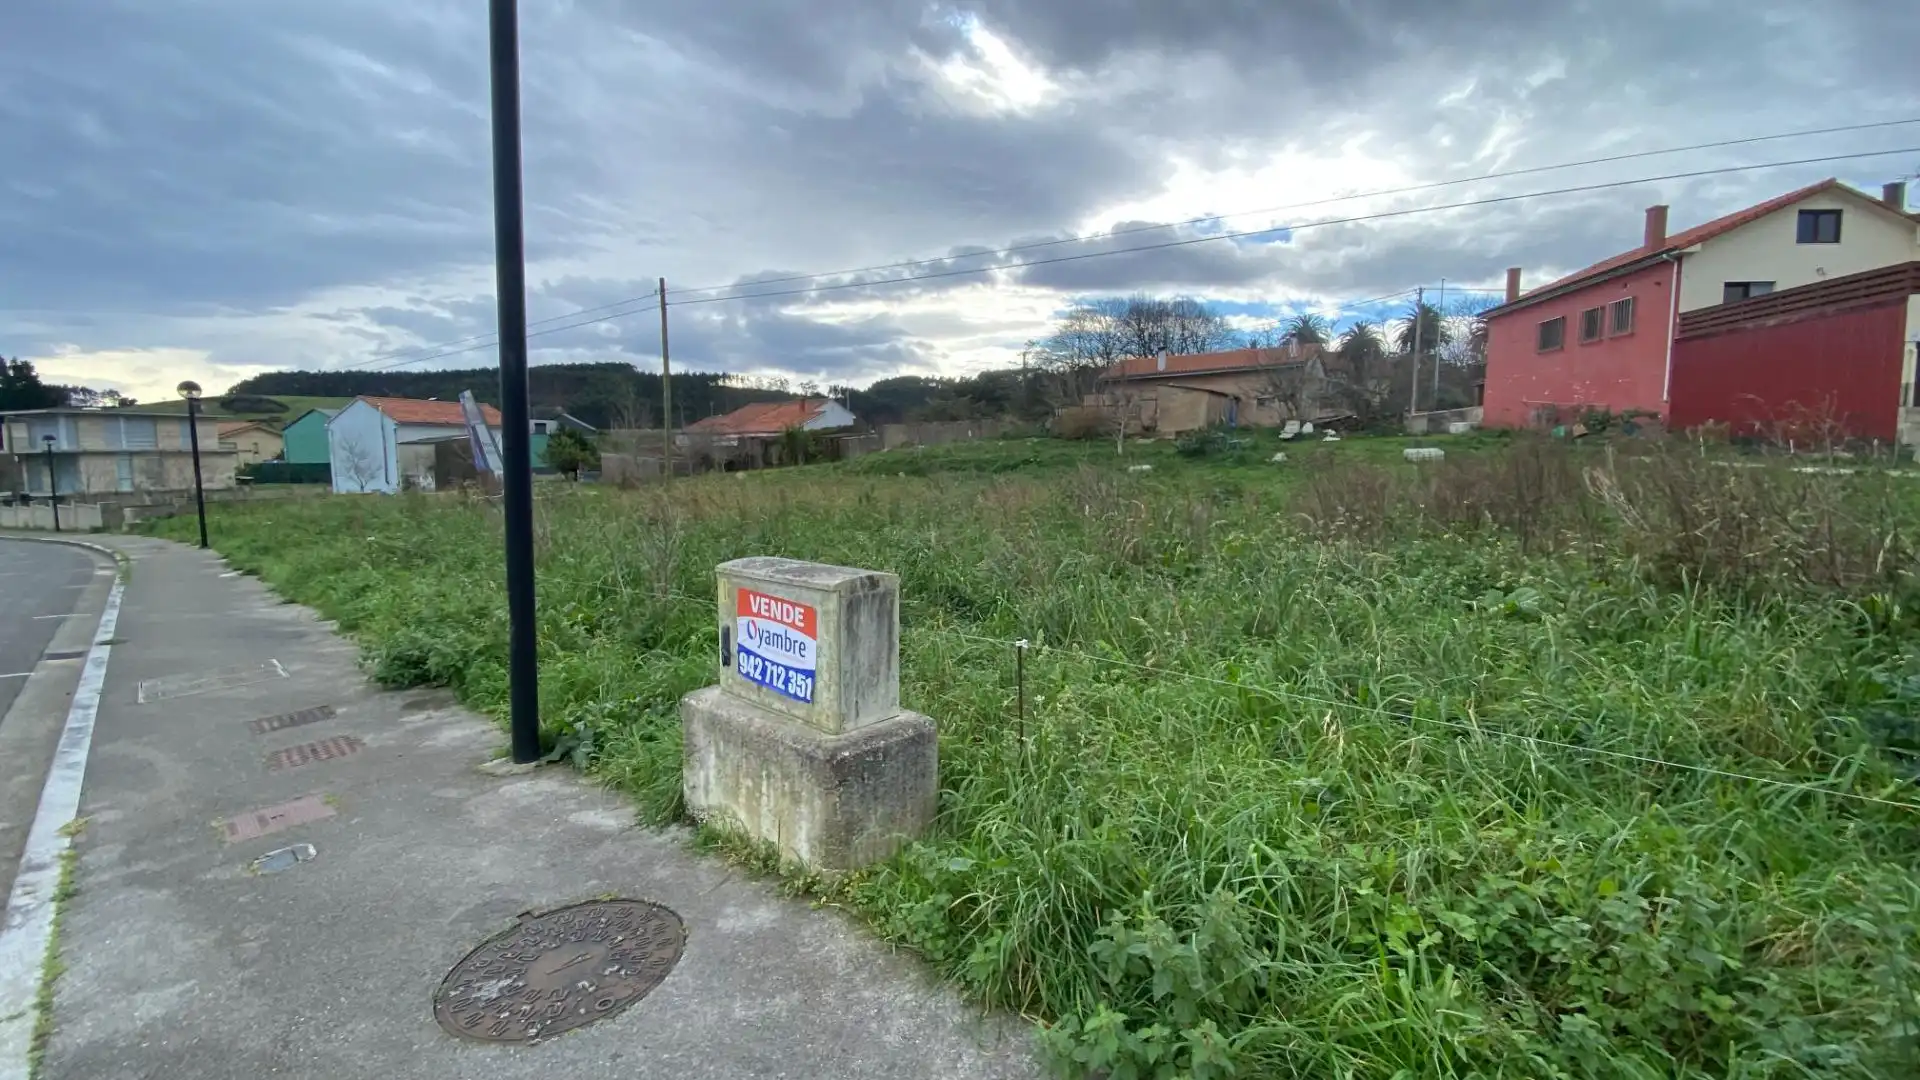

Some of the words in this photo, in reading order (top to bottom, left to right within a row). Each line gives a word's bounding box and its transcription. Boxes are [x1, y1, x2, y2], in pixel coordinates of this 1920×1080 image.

[749, 593, 805, 628] VENDE
[747, 619, 807, 658] Oyambre
[739, 652, 762, 681] 942
[765, 660, 786, 691] 712
[788, 669, 812, 701] 351
